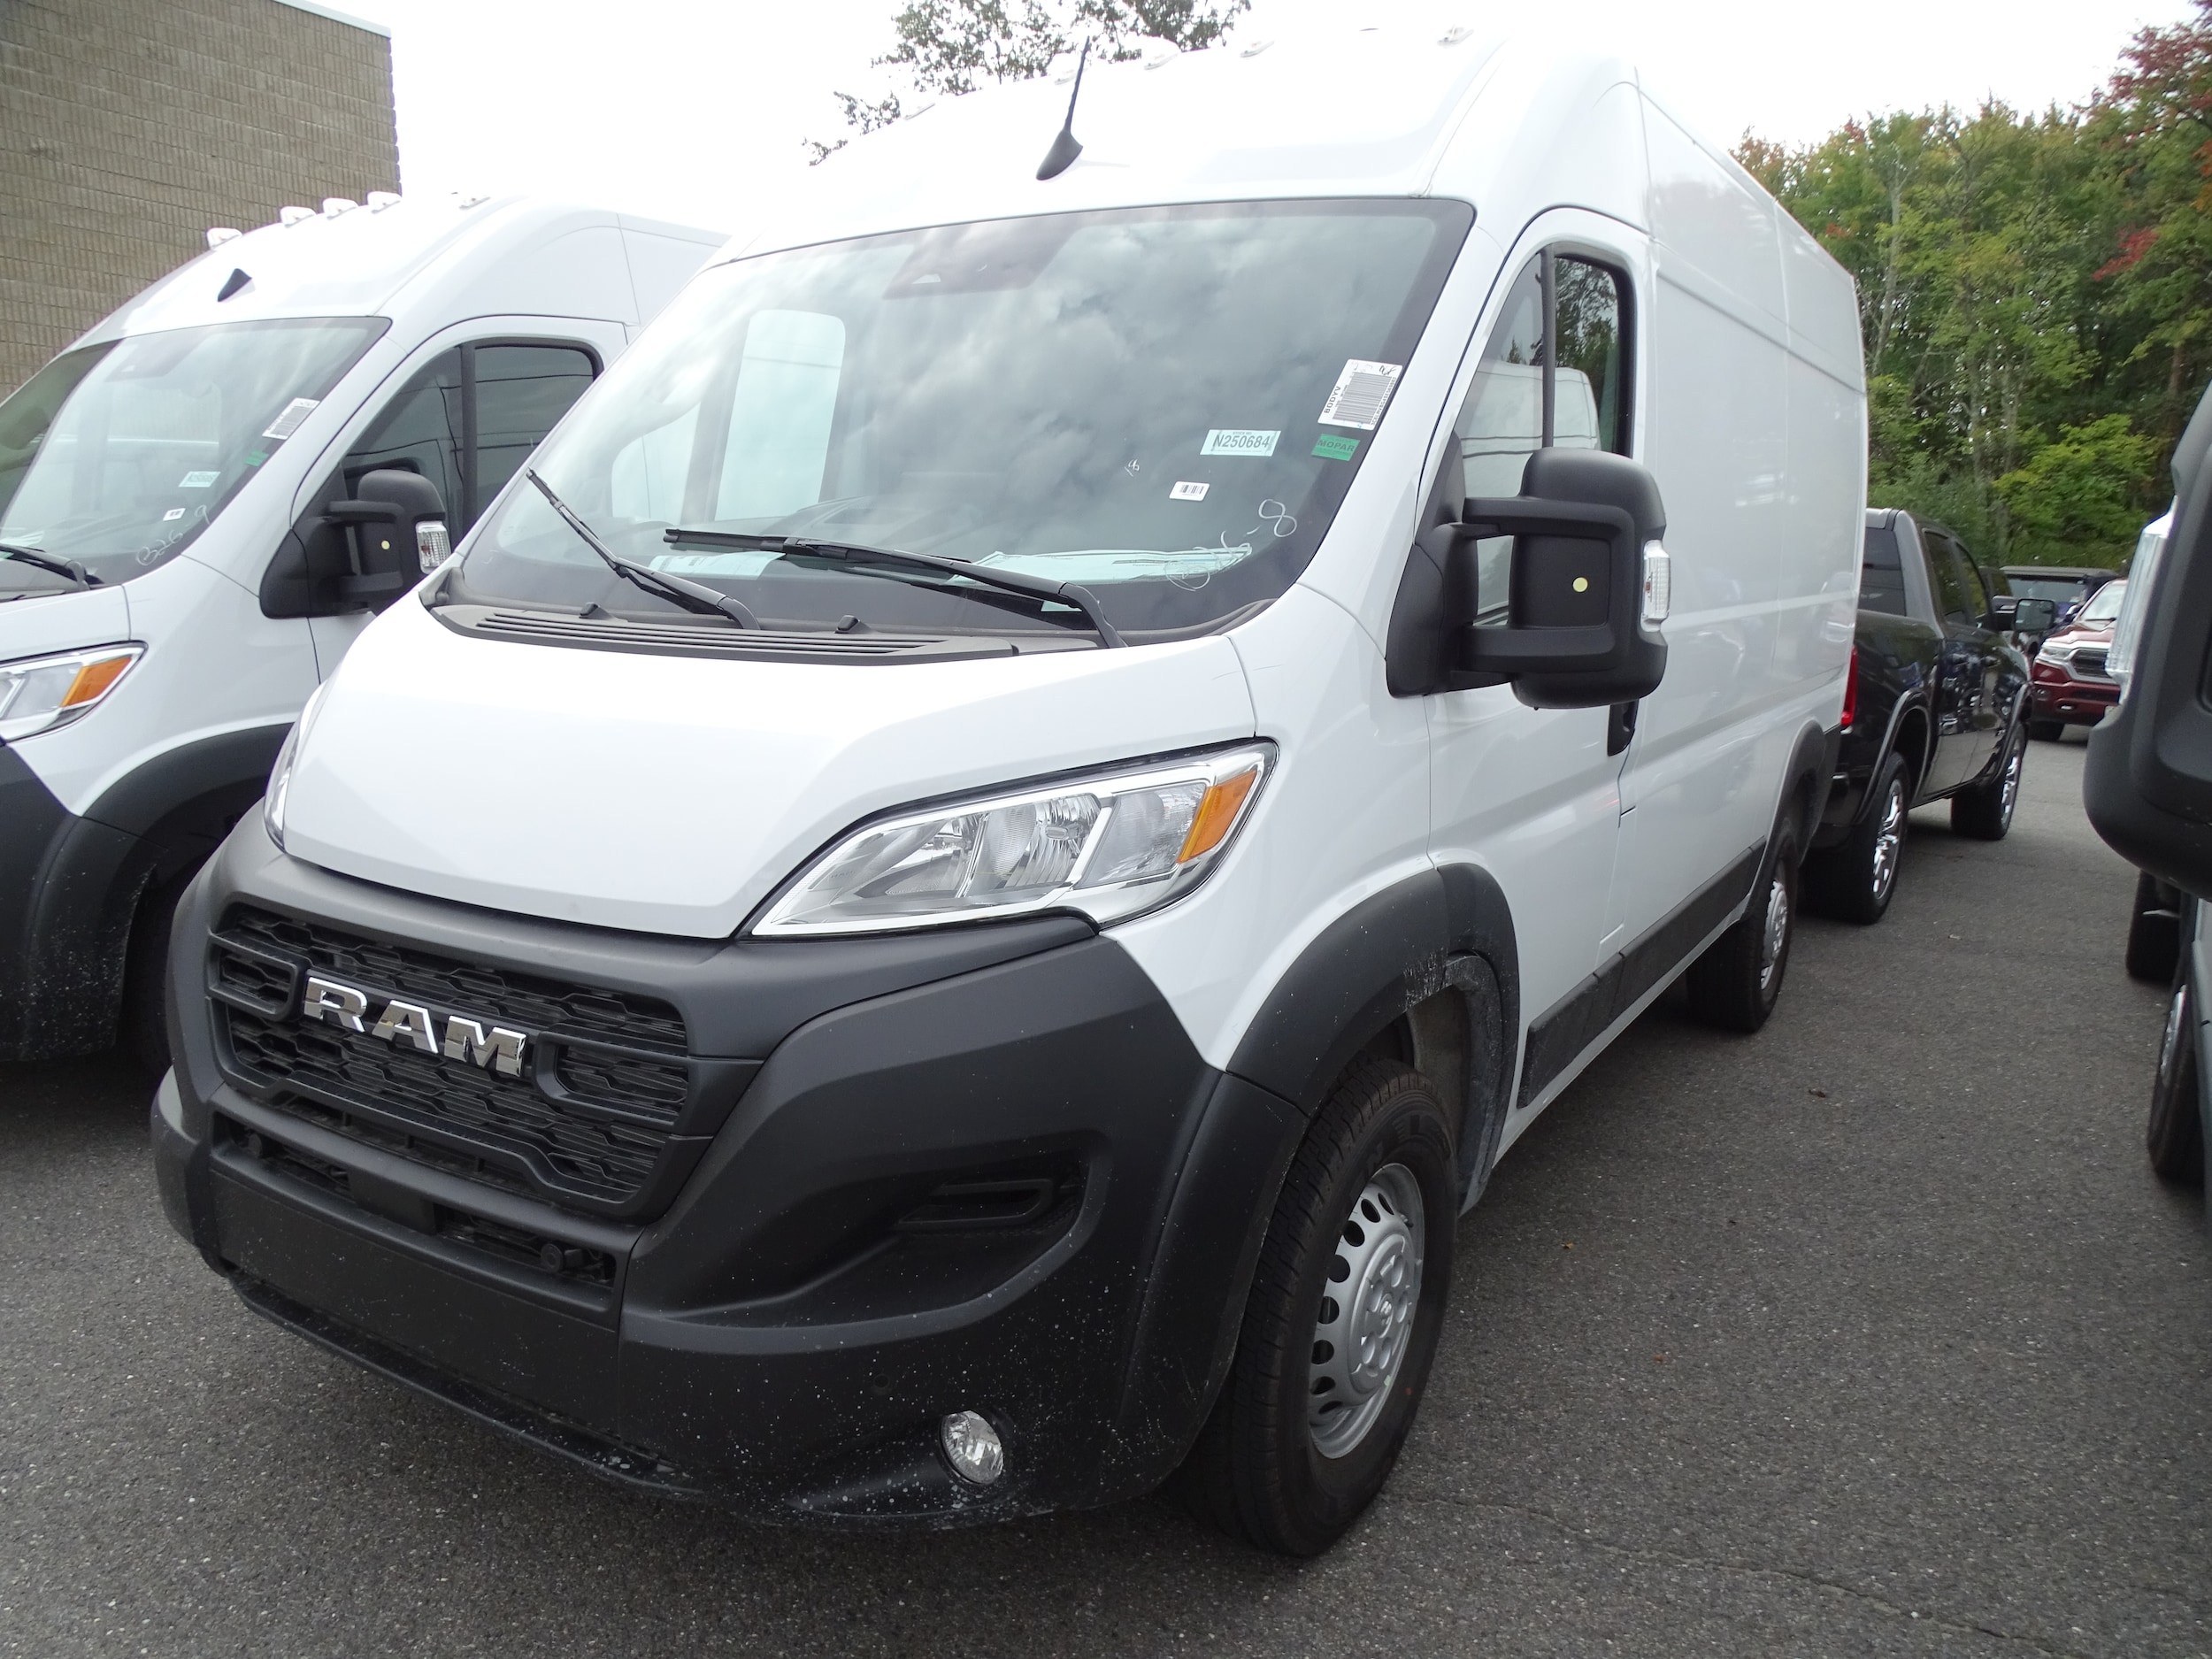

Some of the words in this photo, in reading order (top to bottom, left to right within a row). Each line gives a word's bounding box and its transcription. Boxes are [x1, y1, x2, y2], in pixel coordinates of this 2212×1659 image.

[1324, 386, 1341, 414] BODYV
[1213, 434, 1270, 448] N250684
[1317, 440, 1356, 452] MOPAR
[303, 976, 526, 1077] RAM
